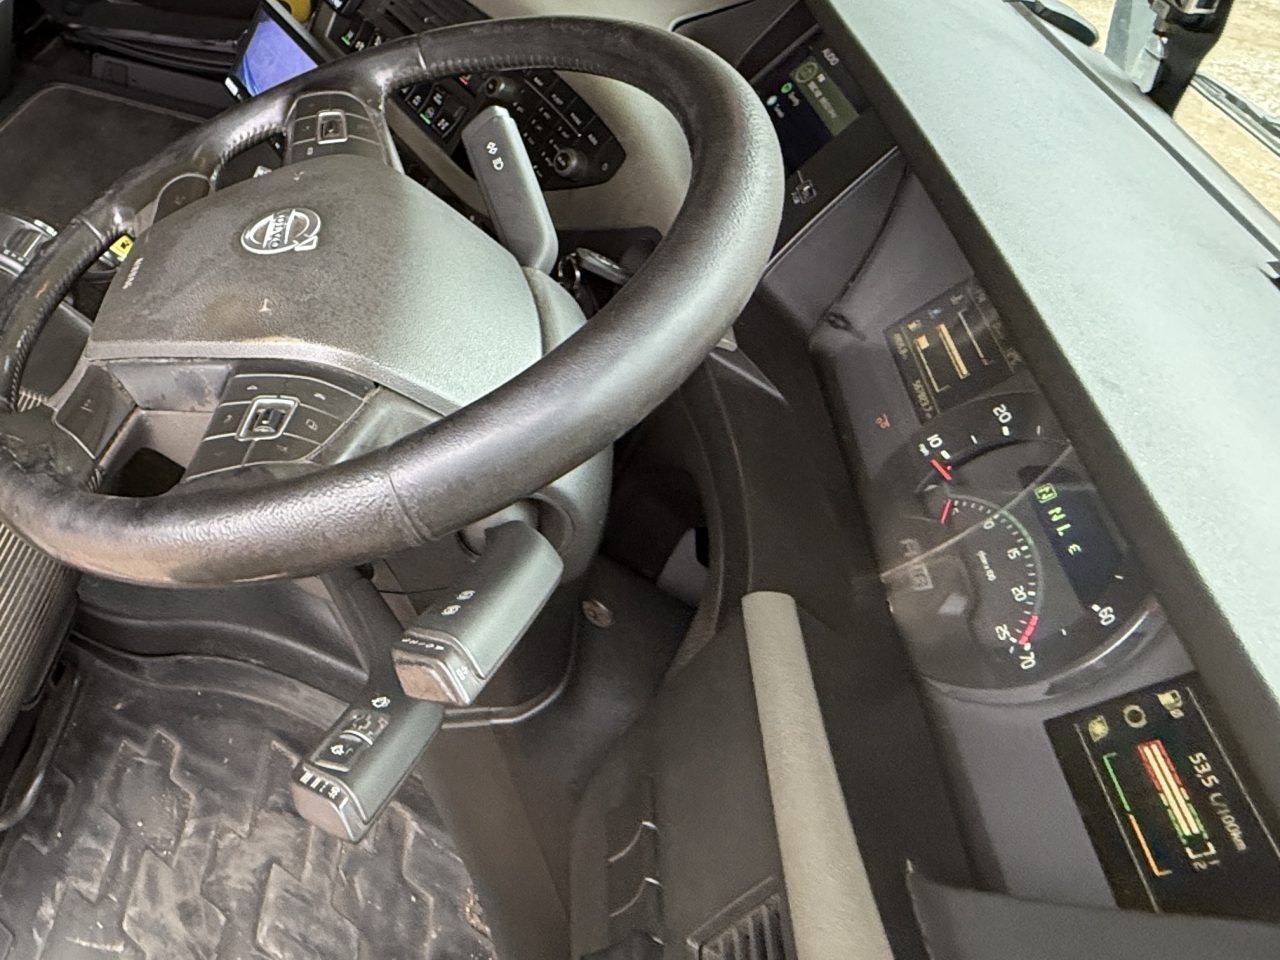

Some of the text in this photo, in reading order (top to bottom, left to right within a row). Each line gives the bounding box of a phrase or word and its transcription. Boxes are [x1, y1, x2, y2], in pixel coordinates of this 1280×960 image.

[992, 403, 1013, 425] 20
[926, 433, 943, 449] 10
[1007, 547, 1021, 560] 15
[1010, 585, 1027, 602] 20
[1098, 605, 1116, 626] 60
[995, 624, 1011, 641] 25
[1019, 651, 1036, 670] 70
